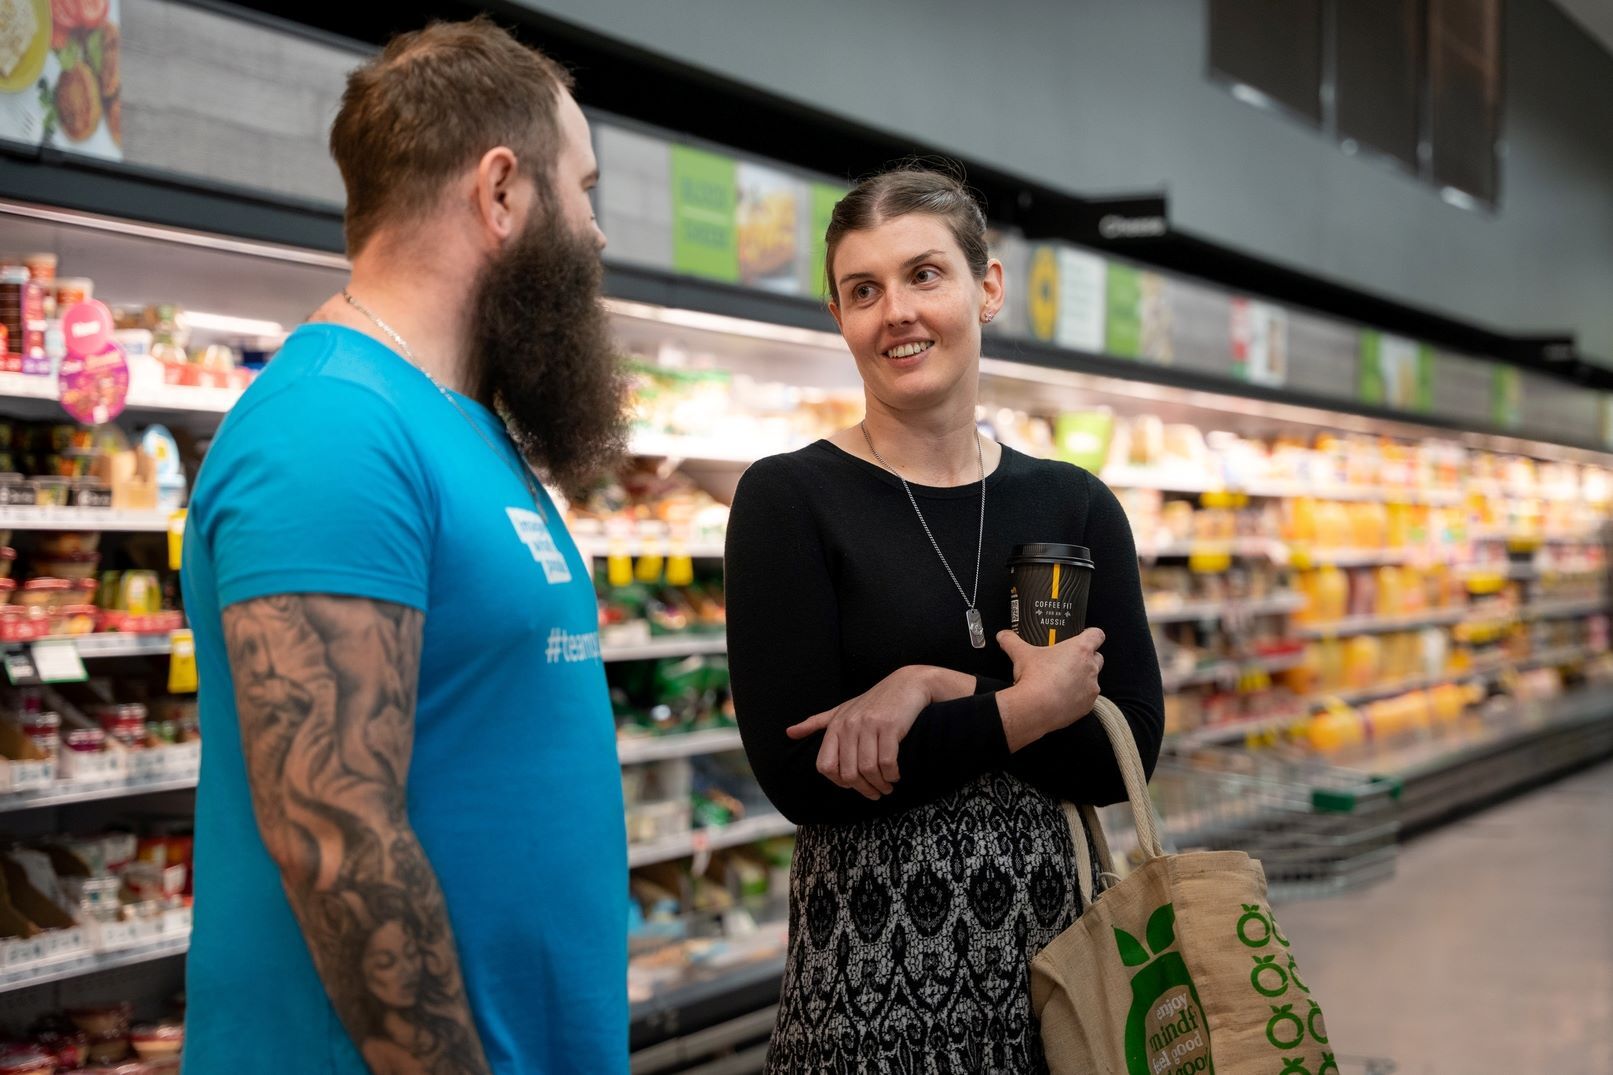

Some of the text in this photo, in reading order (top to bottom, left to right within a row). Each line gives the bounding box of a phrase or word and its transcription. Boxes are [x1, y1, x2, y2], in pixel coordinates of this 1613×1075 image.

[1035, 600, 1060, 609] COFFEE
[1041, 618, 1065, 626] AUSSIE
[1156, 993, 1187, 1020] enjoy
[1171, 1031, 1203, 1064] good
